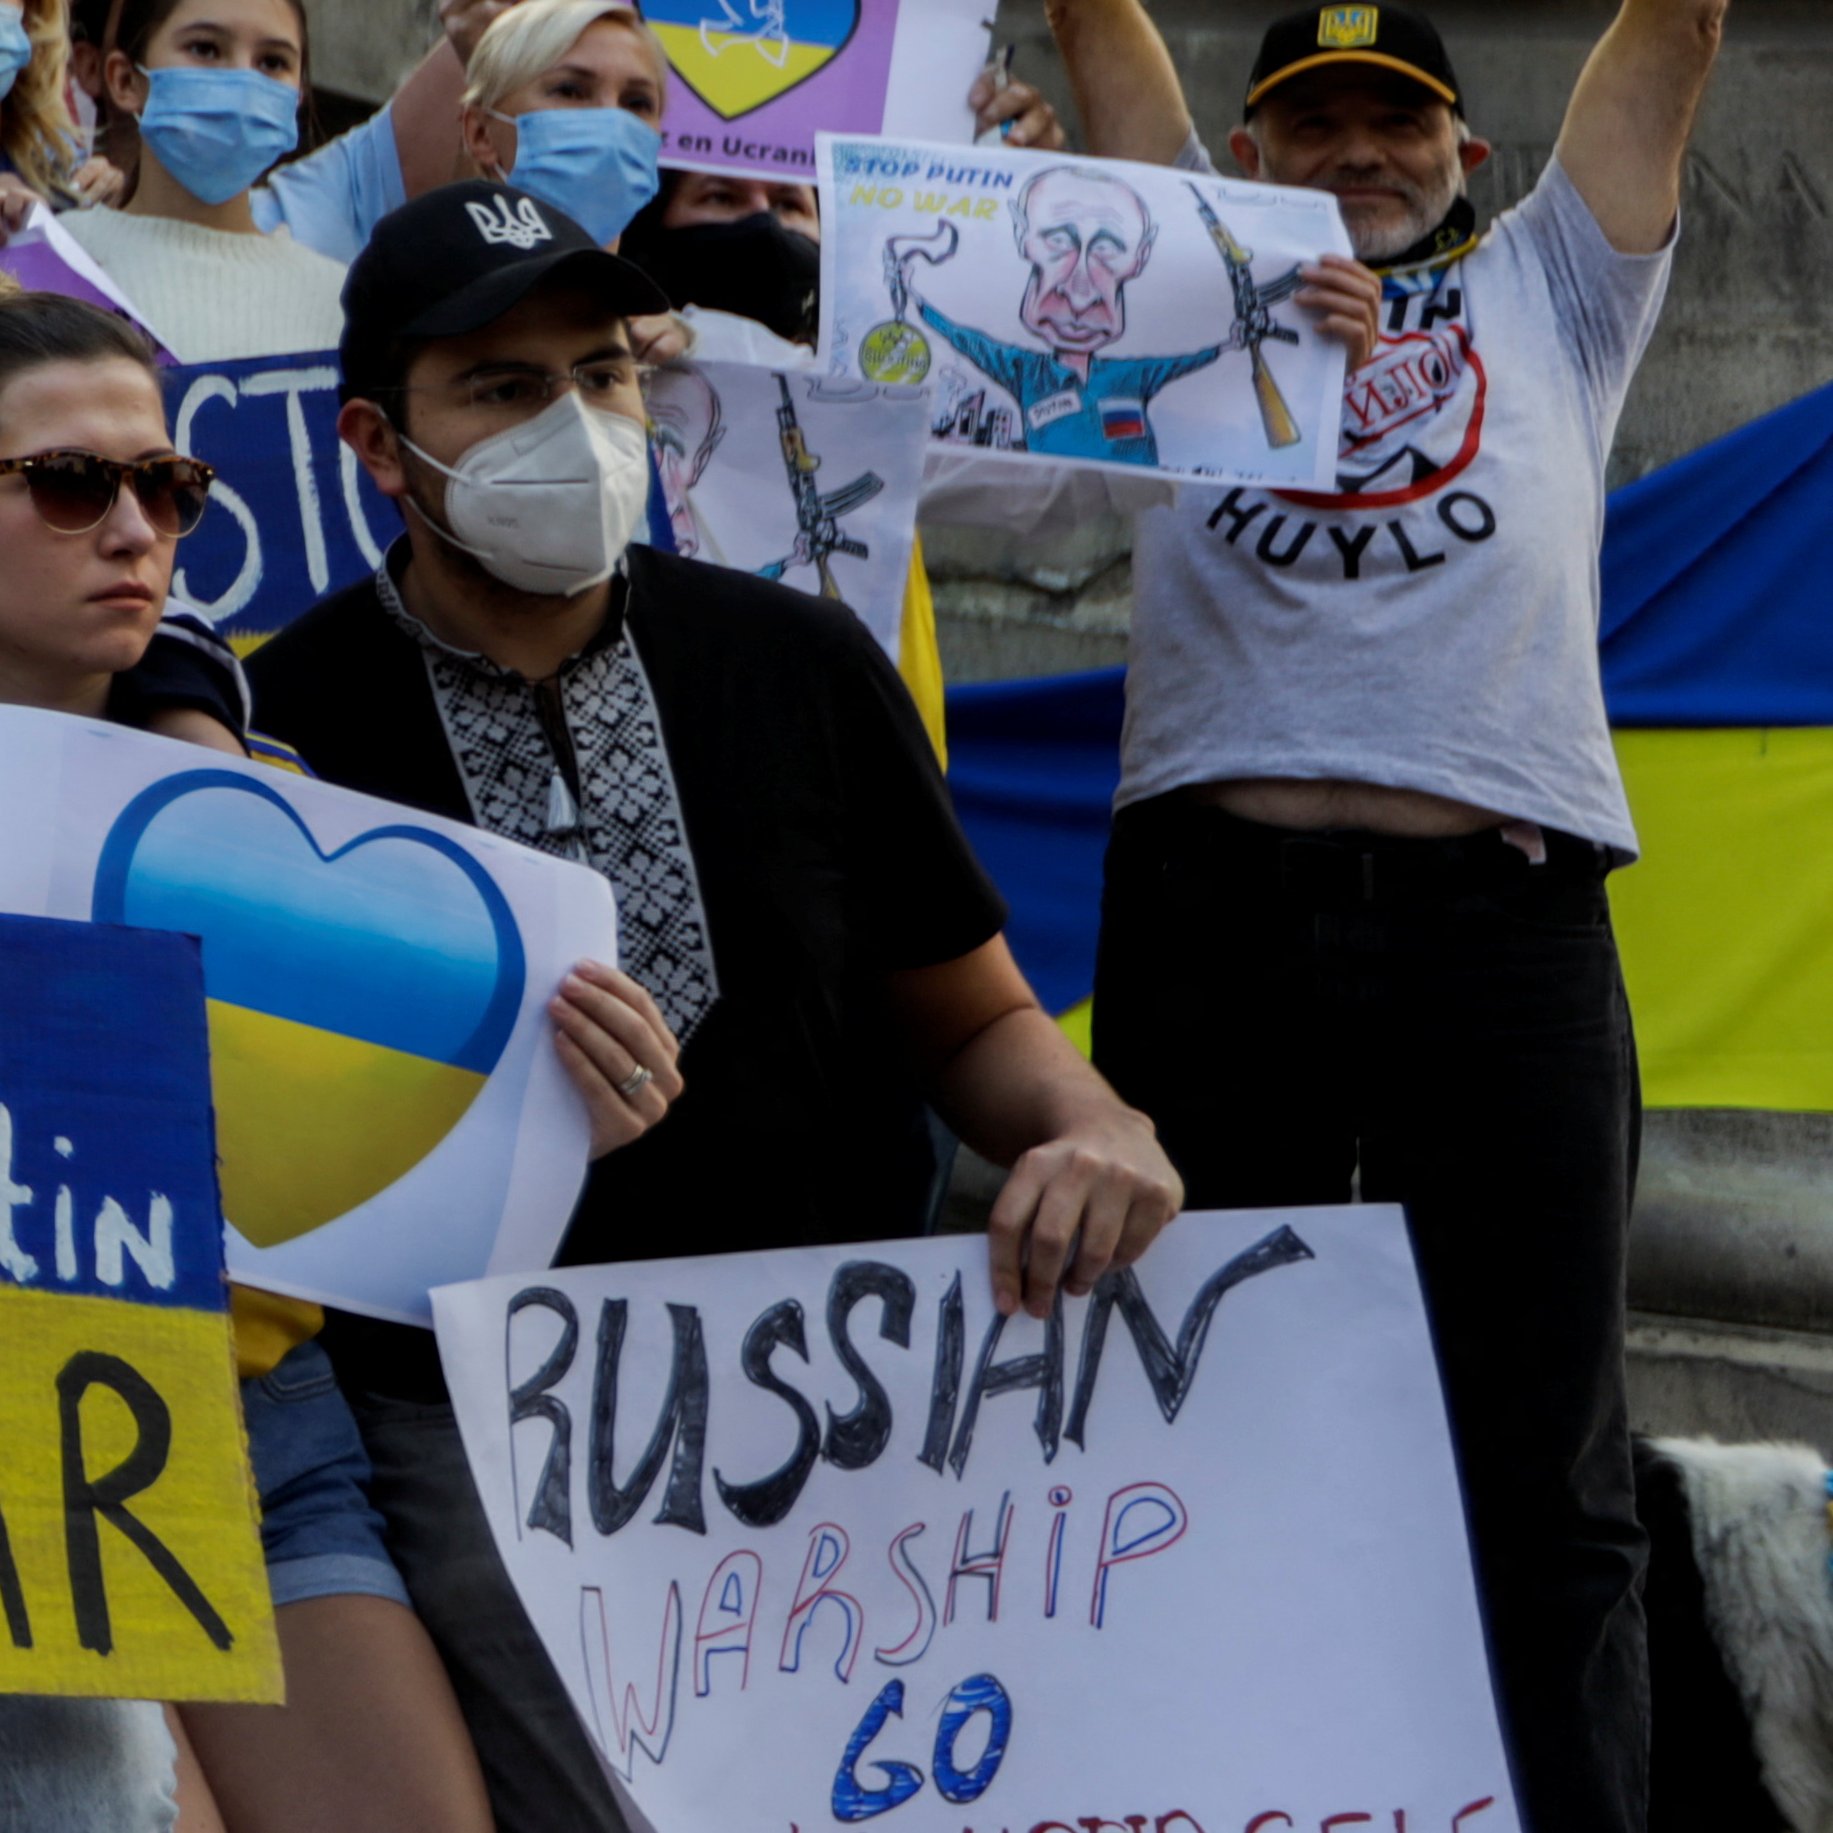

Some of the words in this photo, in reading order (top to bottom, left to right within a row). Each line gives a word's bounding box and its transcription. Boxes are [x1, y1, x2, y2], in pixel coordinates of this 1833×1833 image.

[677, 134, 712, 154] en
[722, 136, 816, 167] Ucrani
[926, 163, 1014, 189] PUTIN
[849, 185, 904, 209] NO
[913, 190, 999, 220] WAR
[1205, 486, 1497, 580] HUYLO
[505, 1223, 1316, 1551] RUSSIAN
[829, 1673, 1013, 1824] GO
